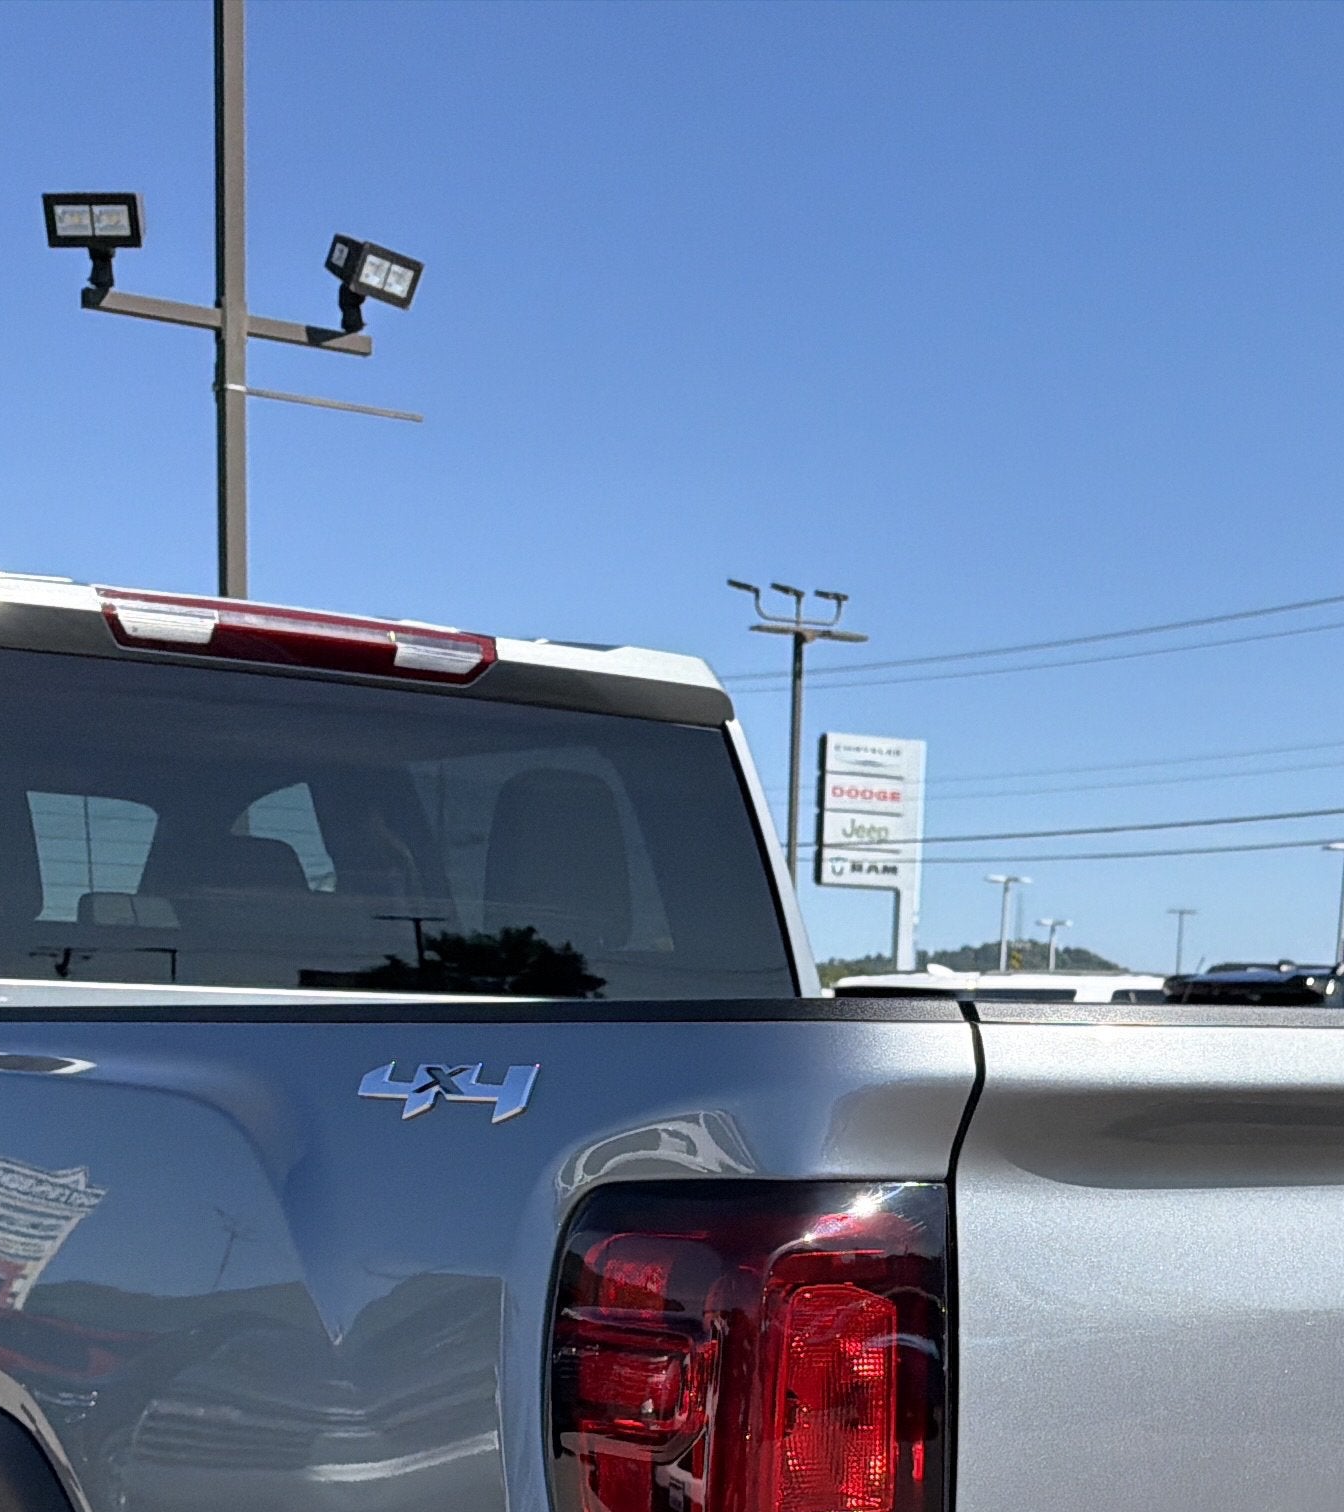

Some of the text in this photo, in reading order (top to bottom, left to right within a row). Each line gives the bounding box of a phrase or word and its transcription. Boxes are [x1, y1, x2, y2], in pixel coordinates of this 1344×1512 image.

[831, 786, 901, 803] DODGE
[841, 818, 889, 845] Jeep
[850, 862, 898, 874] RAM
